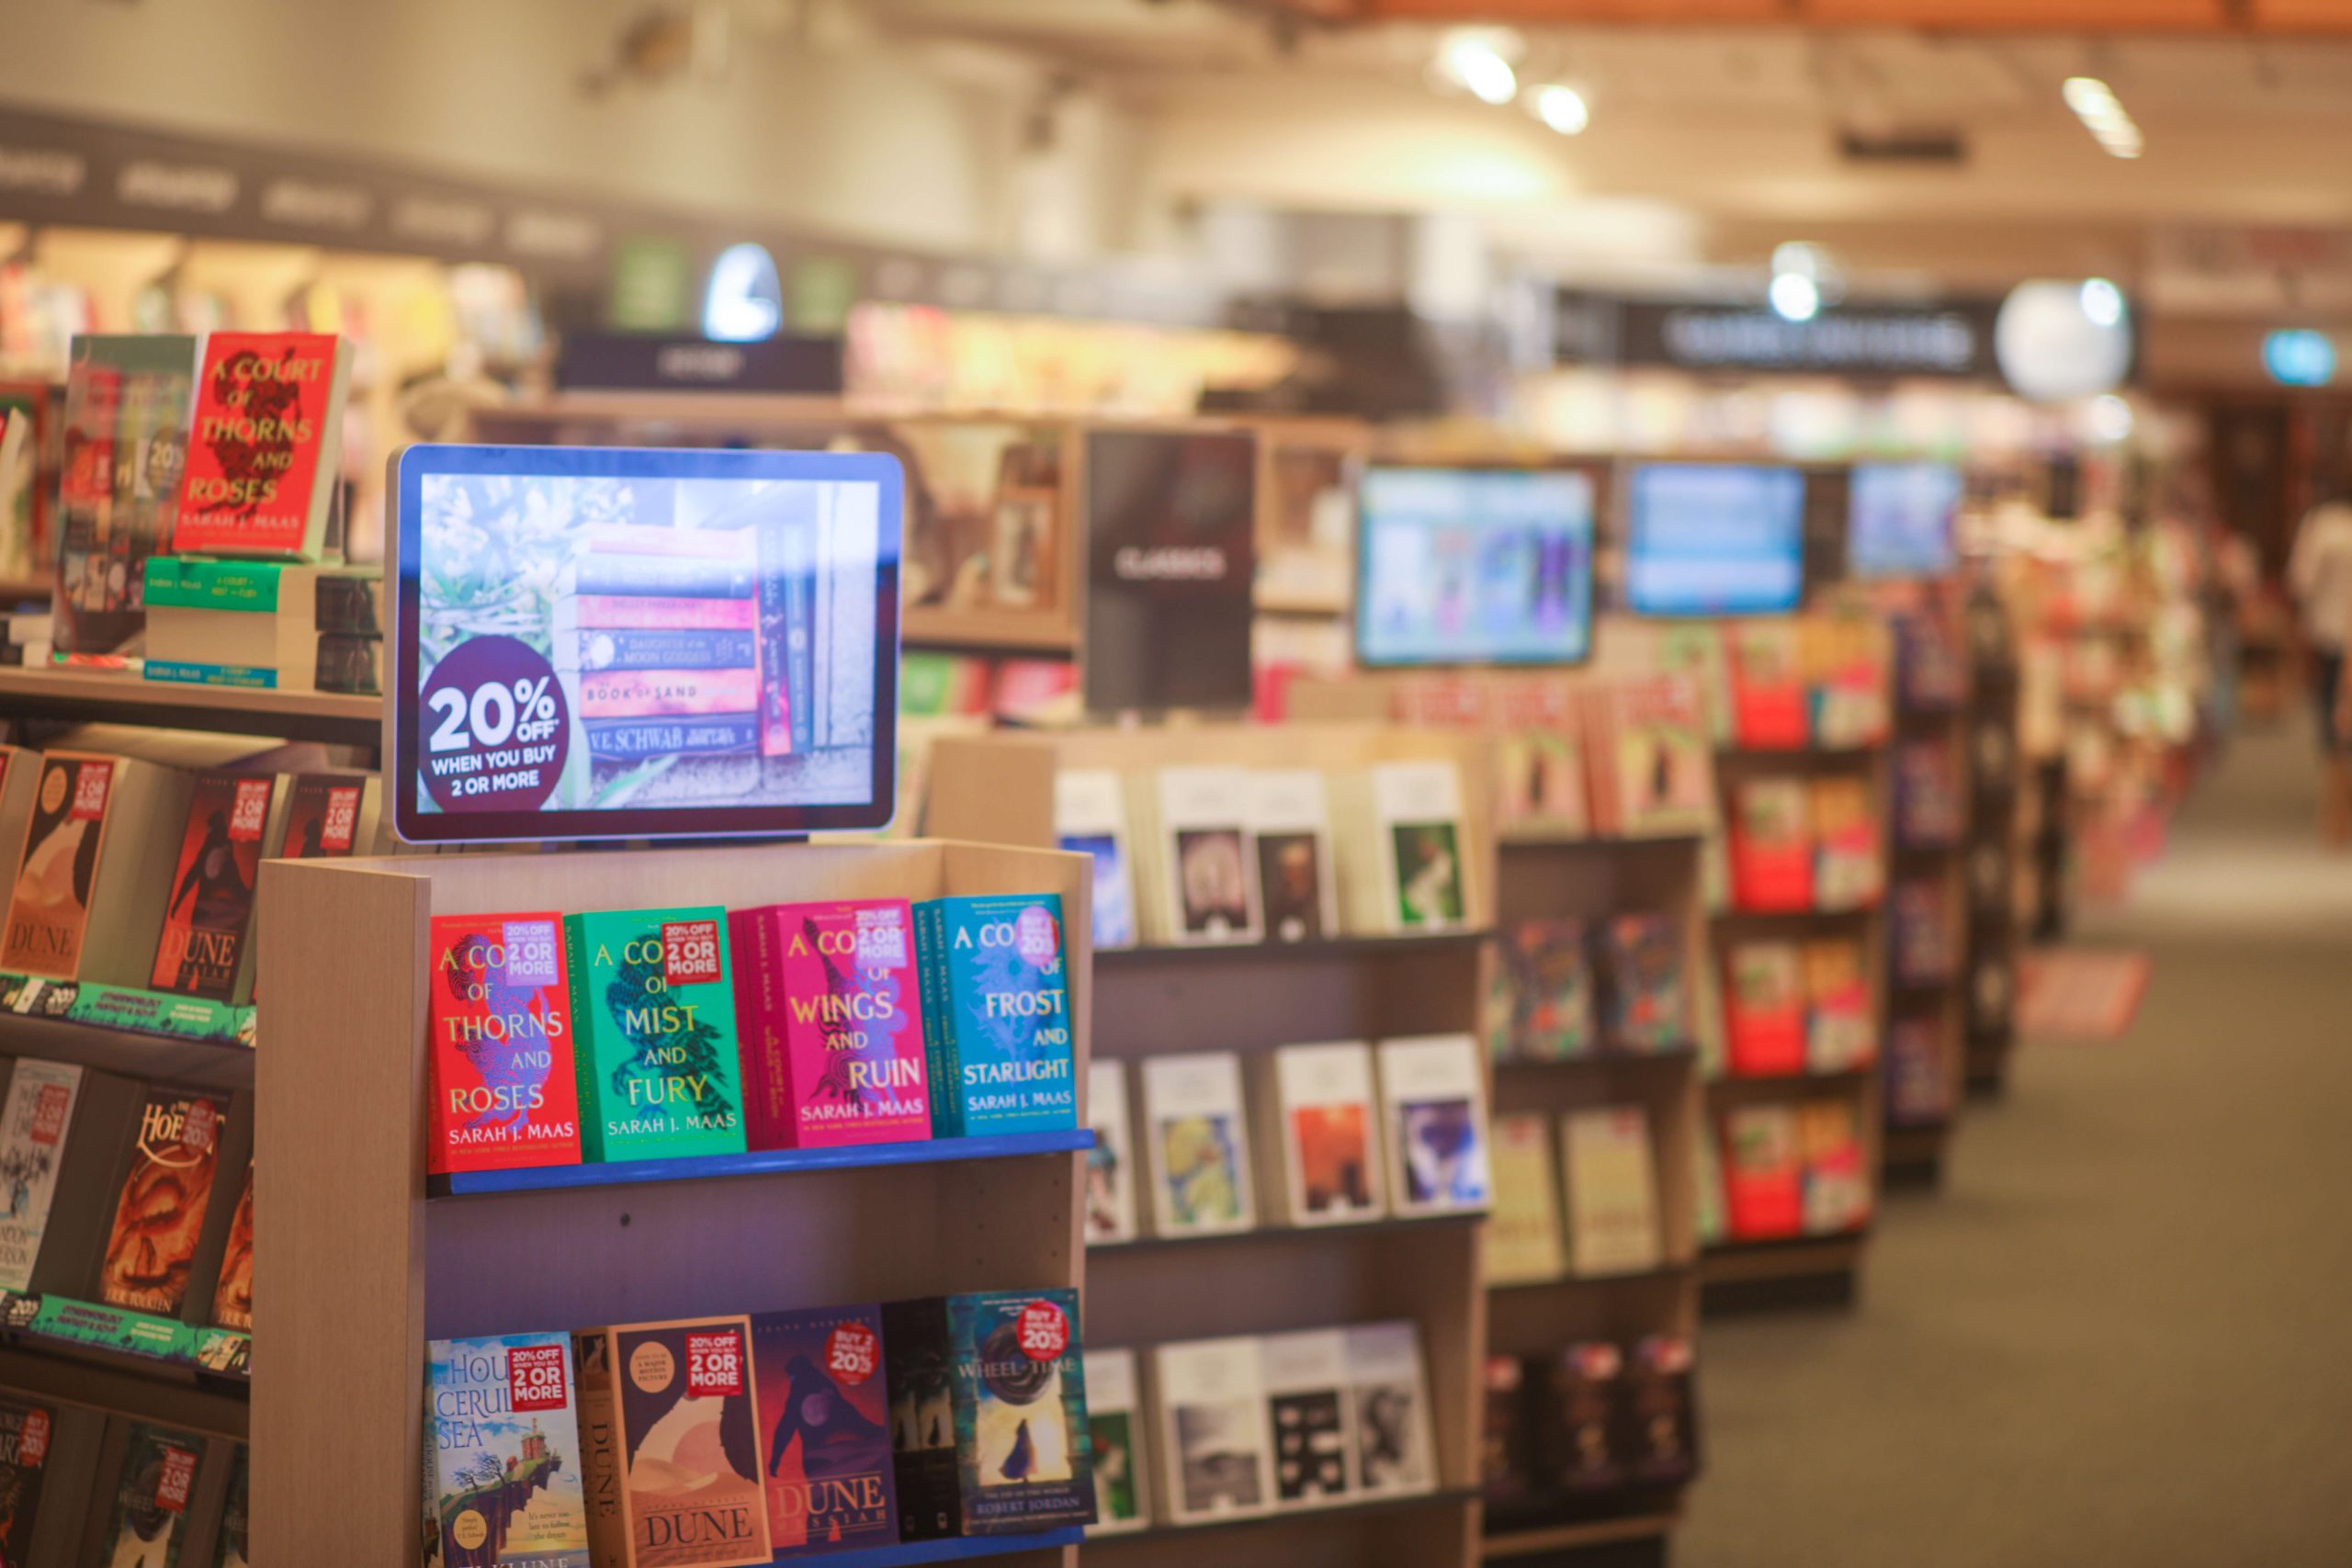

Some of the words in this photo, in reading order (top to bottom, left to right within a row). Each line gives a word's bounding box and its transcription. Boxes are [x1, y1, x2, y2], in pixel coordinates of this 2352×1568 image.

[209, 359, 226, 380] A
[233, 356, 324, 382] COURT
[200, 416, 313, 444] THORNS
[253, 453, 293, 470] AND
[187, 478, 278, 504] ROSES
[183, 513, 234, 528] SARAH
[254, 516, 300, 529] MAAS
[624, 651, 659, 662] MOON
[587, 687, 631, 700] BOOK
[655, 685, 696, 700] SAND
[427, 675, 557, 753] 20%
[615, 727, 683, 751] SCHWAB
[432, 754, 482, 776] WHEN
[485, 750, 520, 769] YOU
[523, 744, 556, 765] BUY
[451, 779, 462, 796] 2
[465, 776, 489, 795] OR
[492, 770, 539, 792] MORE
[235, 800, 243, 816] 2
[244, 799, 264, 816] OR
[327, 809, 334, 825] 2
[336, 809, 353, 824] OR
[232, 815, 261, 830] MORE
[324, 824, 351, 840] MORE
[11, 922, 74, 956] DUNE
[530, 925, 550, 935] OFF
[665, 925, 689, 937] 20%
[690, 923, 714, 935] OFF
[857, 928, 868, 945] 2
[872, 927, 900, 943] OR
[954, 926, 973, 949] A
[165, 928, 236, 966] DUNE
[509, 943, 521, 961] 2
[524, 942, 553, 961] OR
[594, 943, 613, 966] A
[667, 943, 680, 961] 2
[683, 942, 715, 960] OR
[788, 932, 808, 957] A
[859, 943, 902, 960] MORE
[438, 947, 458, 970] A
[510, 961, 554, 976] MORE
[668, 958, 717, 976] MORE
[468, 983, 493, 1000] OF
[762, 974, 773, 1012] MAAS
[570, 985, 580, 1023] MAAS
[789, 990, 894, 1026] WINGS
[986, 990, 1065, 1018] FROST
[442, 1011, 563, 1042] THORNS
[626, 1004, 698, 1036] MIST
[826, 1032, 868, 1052] AND
[1033, 1028, 1068, 1046] AND
[511, 1050, 551, 1069] AND
[644, 1046, 686, 1066] AND
[848, 1057, 921, 1089] RUIN
[964, 1058, 1069, 1085] STARLIGHT
[450, 1084, 544, 1113] ROSES
[628, 1075, 708, 1106] FURY
[968, 1094, 1017, 1111] SARAH
[1033, 1090, 1072, 1106] MAAS
[801, 1103, 859, 1122] SARAH
[878, 1098, 924, 1117] MAAS
[449, 1126, 506, 1145] SARAH
[513, 1126, 522, 1143] J.
[527, 1122, 573, 1139] MAAS
[608, 1118, 664, 1135] SARAH
[671, 1117, 679, 1133] J.
[686, 1112, 736, 1130] MAAS
[131, 1291, 173, 1314] TOLKIEN
[1025, 1310, 1051, 1321] BUY
[690, 1337, 712, 1348] 20%
[714, 1336, 737, 1346] OFF
[835, 1331, 863, 1343] BUY
[513, 1352, 536, 1362] 20%
[537, 1349, 560, 1360] OFF
[691, 1355, 703, 1372] 2
[707, 1354, 737, 1371] OR
[450, 1354, 509, 1383] HOU
[514, 1370, 526, 1387] 2
[530, 1367, 560, 1385] OR
[958, 1361, 1019, 1378] WHEEL
[1029, 1357, 1076, 1375] TIME
[691, 1372, 739, 1386] MORE
[436, 1388, 513, 1418] CERUL
[514, 1385, 562, 1402] MORE
[439, 1418, 483, 1450] SEA
[172, 1471, 190, 1487] OR
[592, 1421, 617, 1517] DUNE
[776, 1475, 887, 1519] DUNE
[977, 1501, 1024, 1515] ROBERT
[1029, 1496, 1080, 1511] JORDAN
[644, 1508, 753, 1547] DUNE
